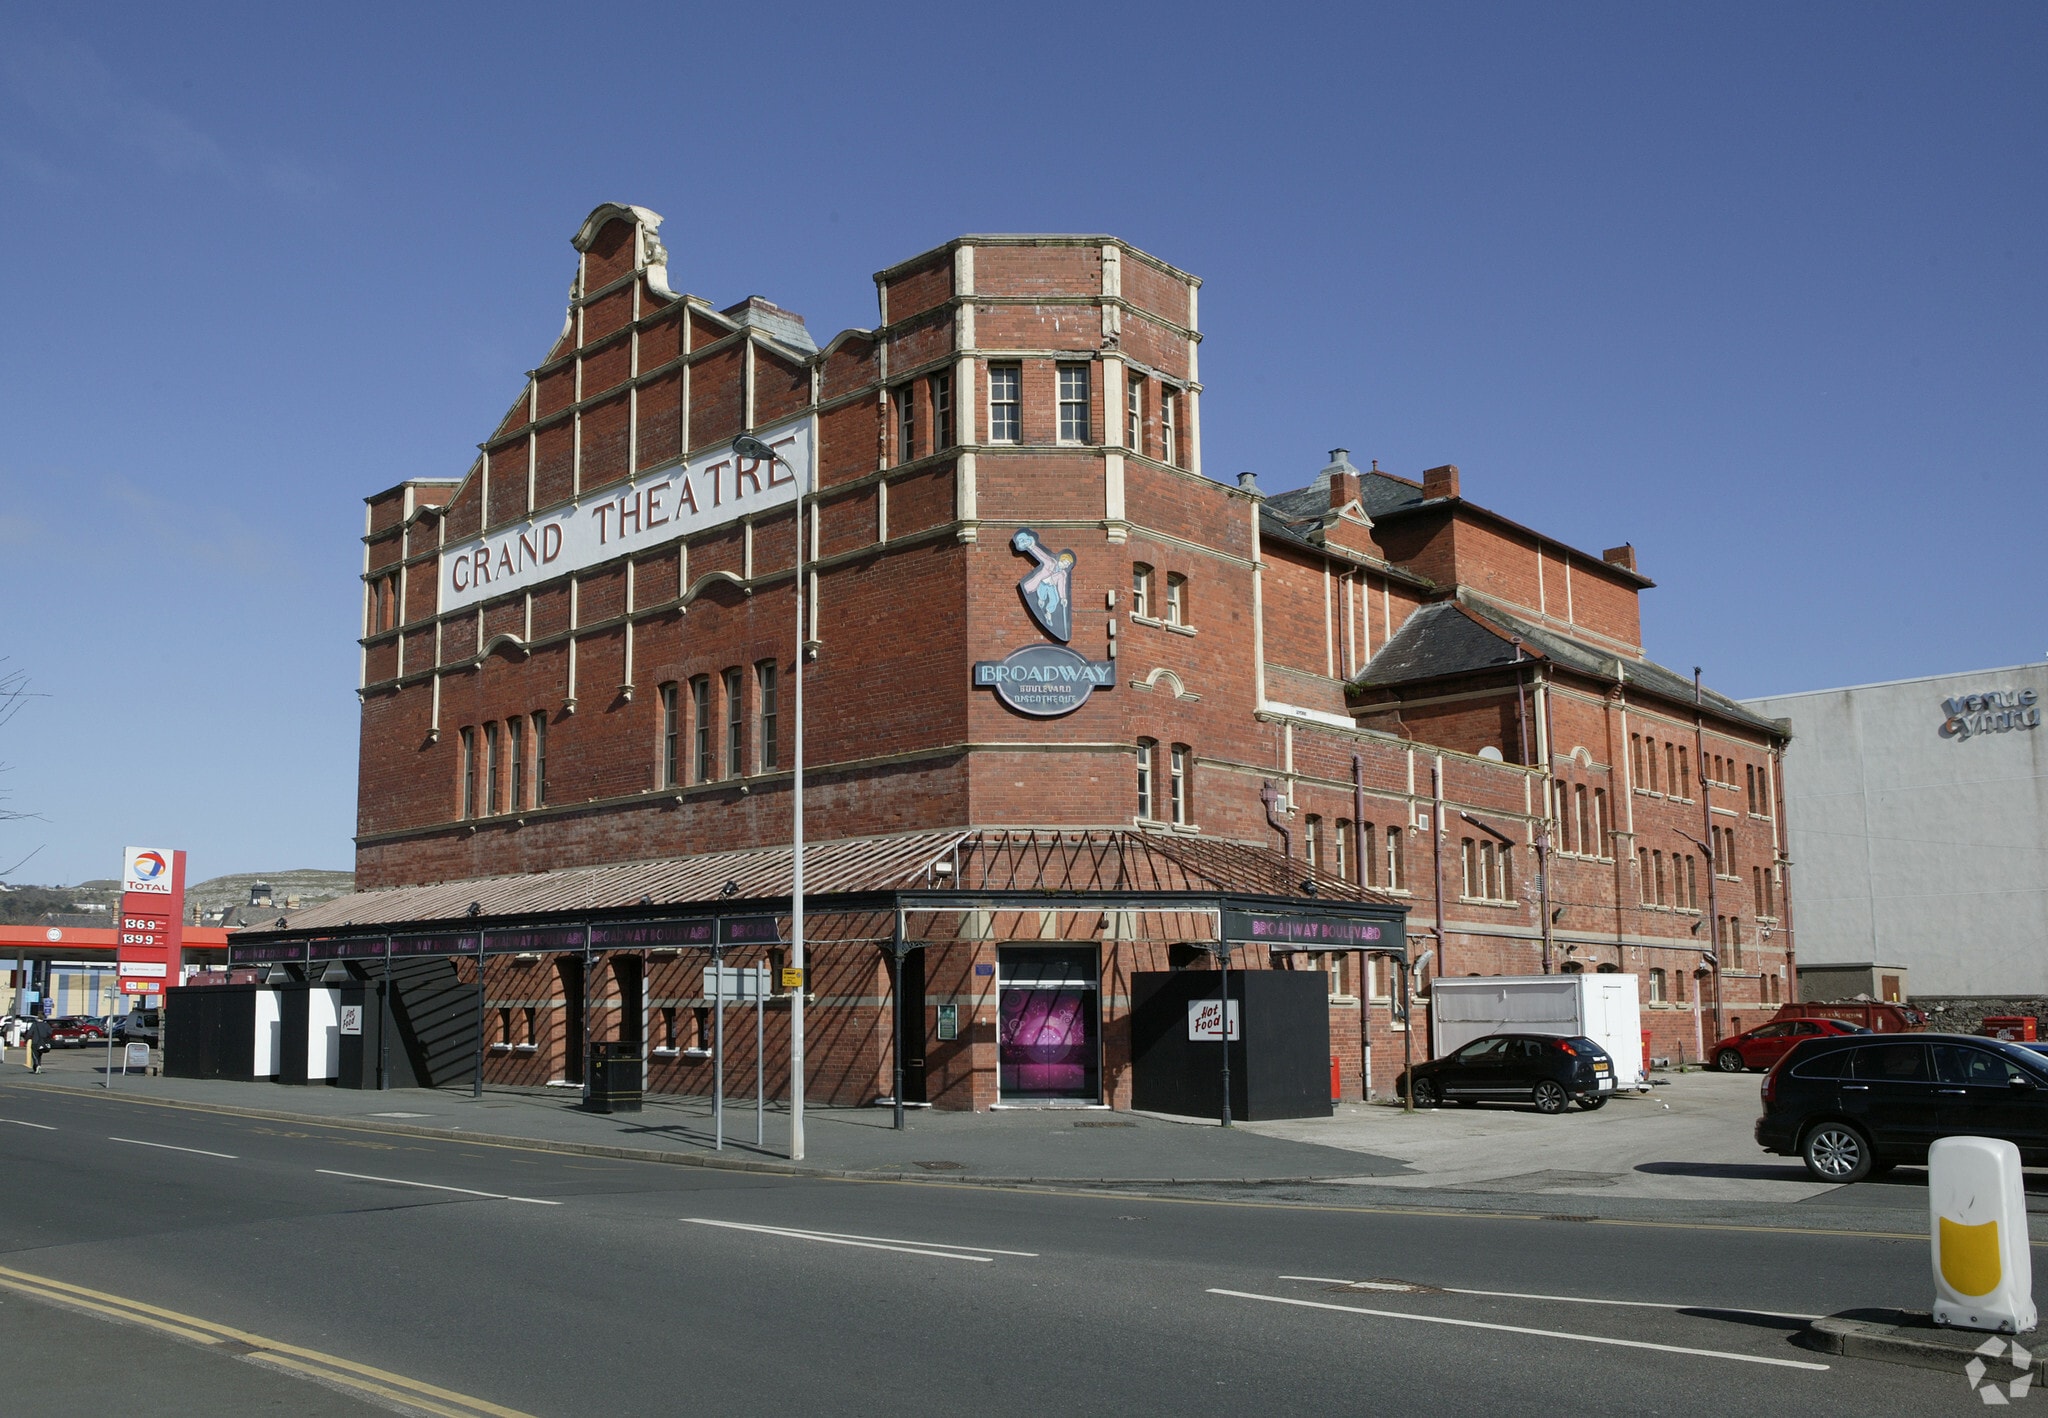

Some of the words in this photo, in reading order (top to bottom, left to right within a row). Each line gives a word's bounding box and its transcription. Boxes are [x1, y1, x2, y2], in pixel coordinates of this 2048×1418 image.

[452, 522, 564, 592] GRAND
[592, 435, 798, 545] THEATRE
[981, 664, 1112, 683] BROADWAY
[1019, 685, 1072, 693] BOULEVARD
[127, 881, 169, 892] TOTAL
[124, 918, 156, 930] 136.9
[731, 923, 775, 938] BROAD
[1252, 920, 1318, 937] BROADWAY
[1322, 926, 1381, 940] BOULEVARD
[123, 933, 154, 945] 139.9
[591, 928, 647, 943] BROADWAY
[1201, 1004, 1219, 1019] Hot
[1195, 1014, 1221, 1032] Food
